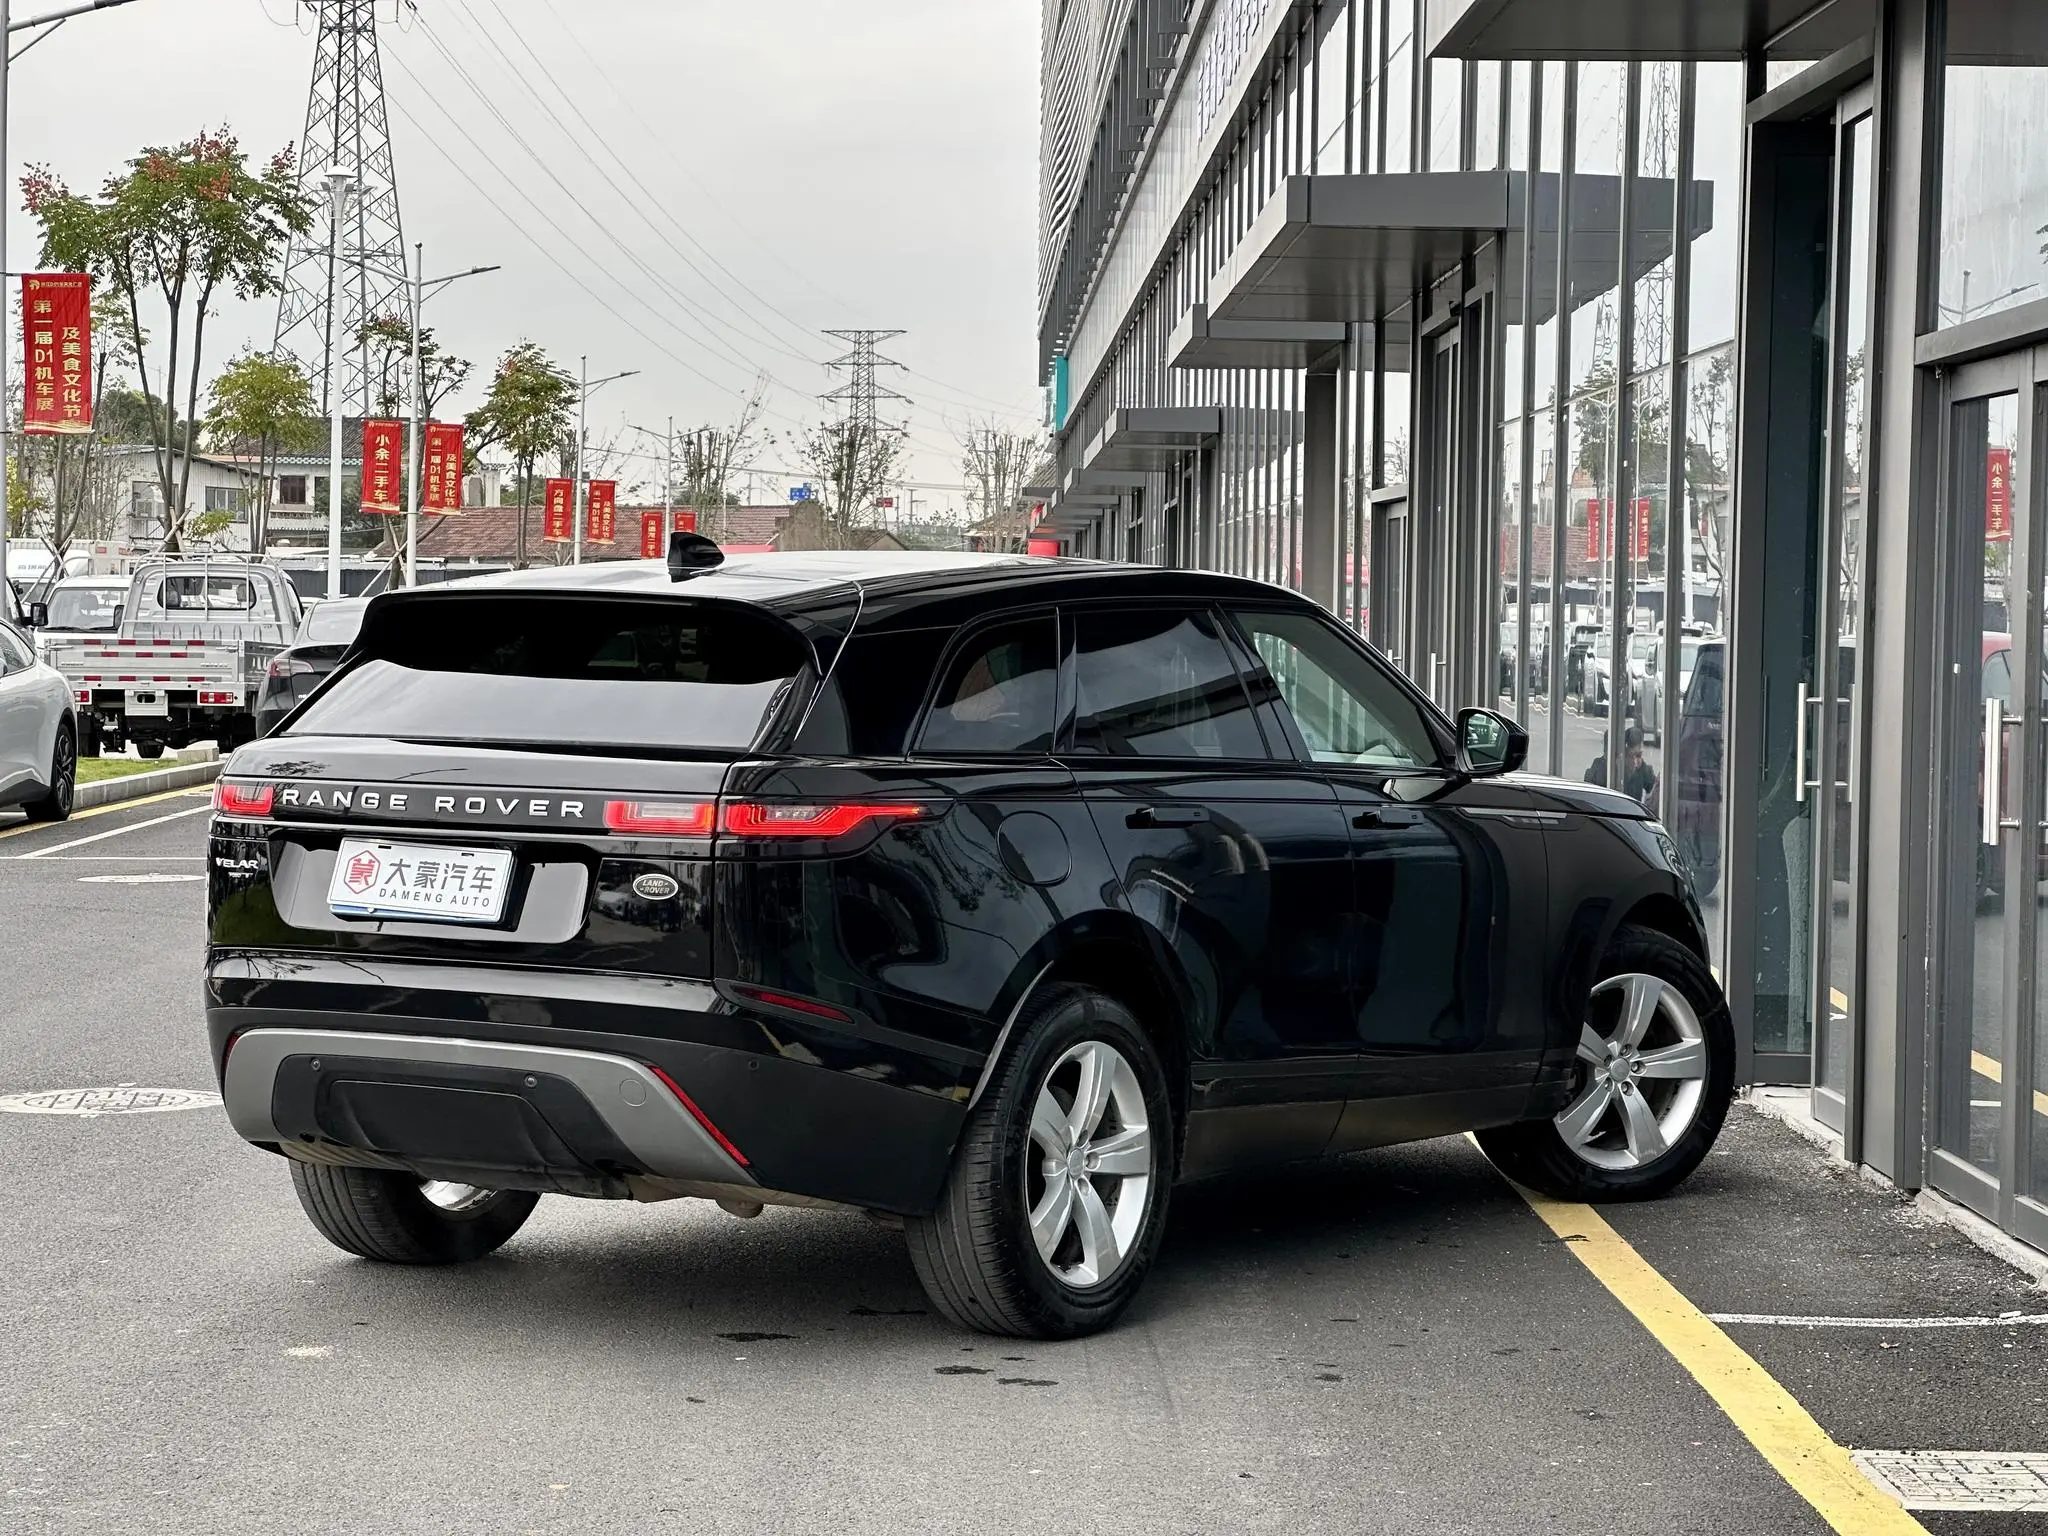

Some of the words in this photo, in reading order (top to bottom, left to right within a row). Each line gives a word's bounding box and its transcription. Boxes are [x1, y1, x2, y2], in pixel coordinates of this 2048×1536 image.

[33, 299, 55, 411] 第一届D1机车展
[61, 326, 82, 418] 及美食文化节
[373, 434, 391, 502] 小余二手车
[445, 453, 457, 506] 及美食文化节
[282, 789, 408, 811] RANGE
[434, 796, 584, 818] ROVER
[215, 857, 259, 870] VELAR
[384, 858, 496, 893] 大蒙汽车
[379, 888, 443, 903] DAMENG
[450, 895, 490, 907] AUTO
